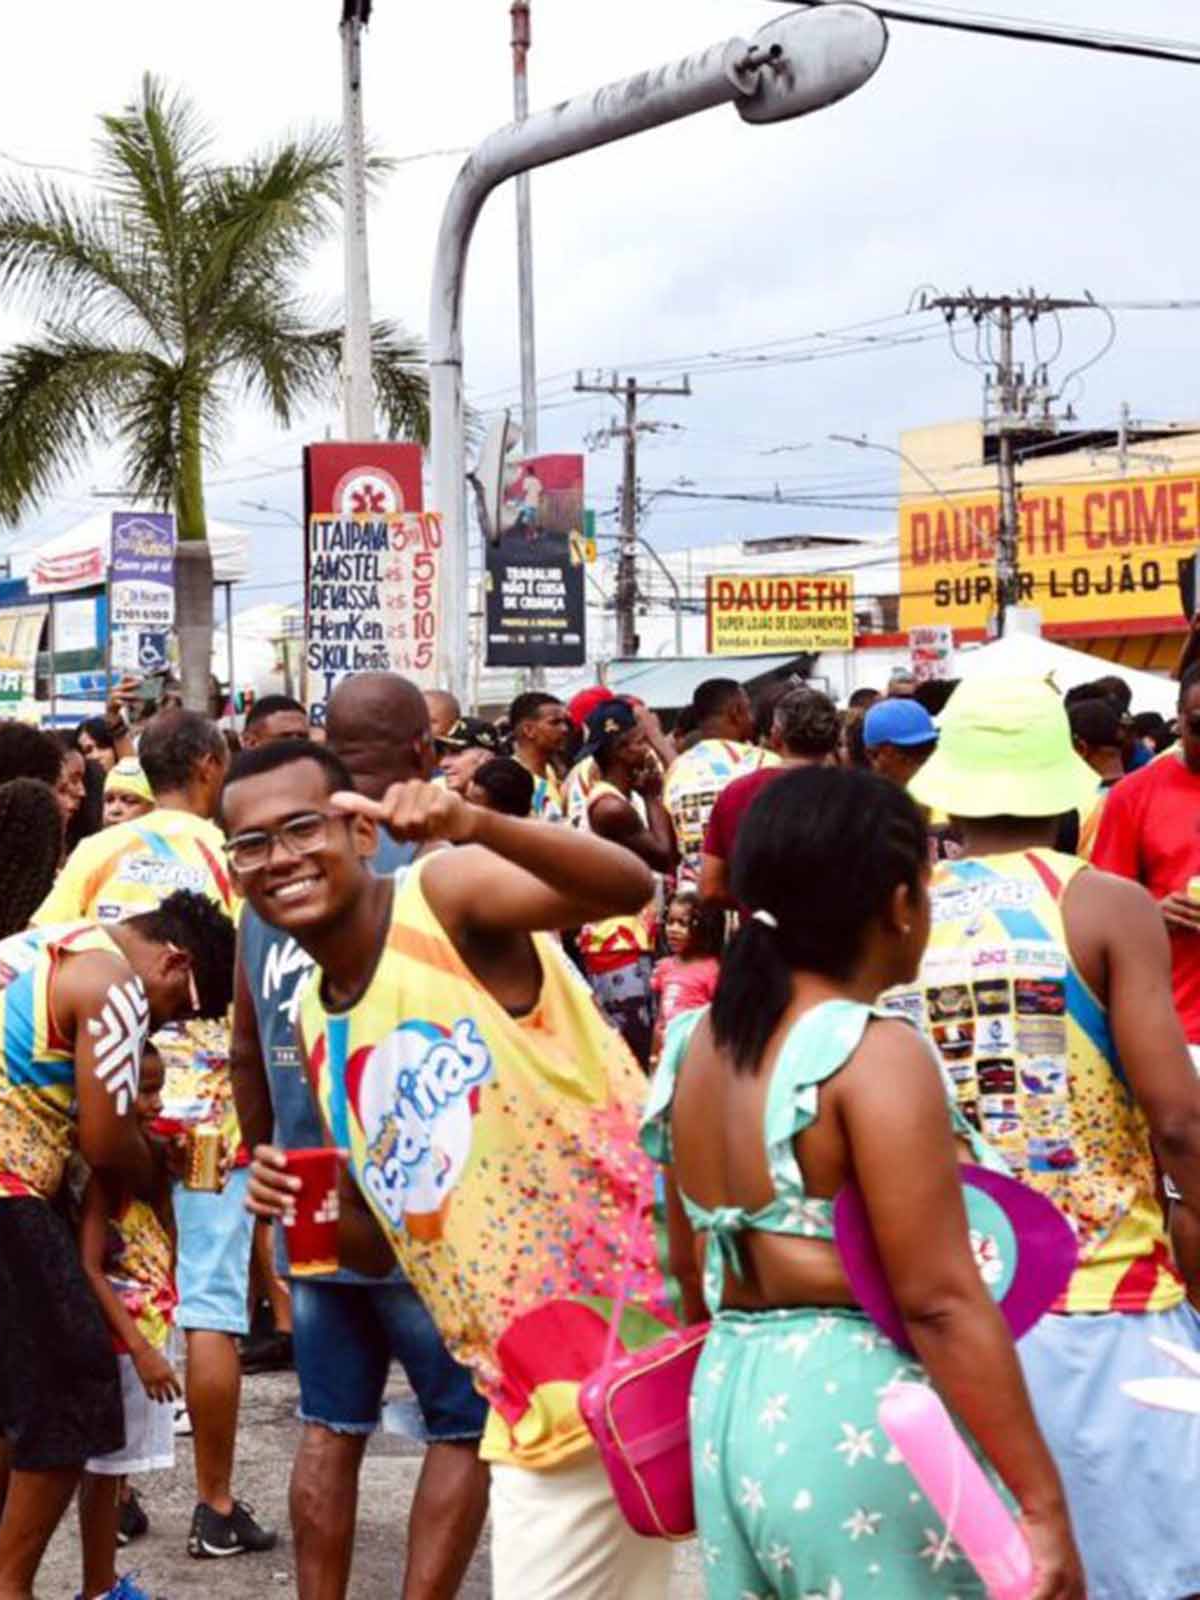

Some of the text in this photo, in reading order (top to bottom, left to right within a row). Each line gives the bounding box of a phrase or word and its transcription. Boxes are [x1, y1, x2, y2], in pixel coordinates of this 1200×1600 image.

[313, 520, 389, 551] ITAIPAVA
[392, 521, 407, 551] 3
[418, 513, 443, 551] 10
[911, 481, 1200, 565] DAUDTH COME
[312, 554, 383, 582] AMSTEL
[412, 553, 434, 582] 5
[934, 553, 1160, 607] SUPR LOJÃO
[311, 584, 381, 610] DEVASSA
[413, 584, 432, 610] 5
[717, 580, 847, 611] DAUDETH
[413, 611, 434, 639] 10
[307, 643, 351, 670] SKOL
[413, 643, 434, 670] 5
